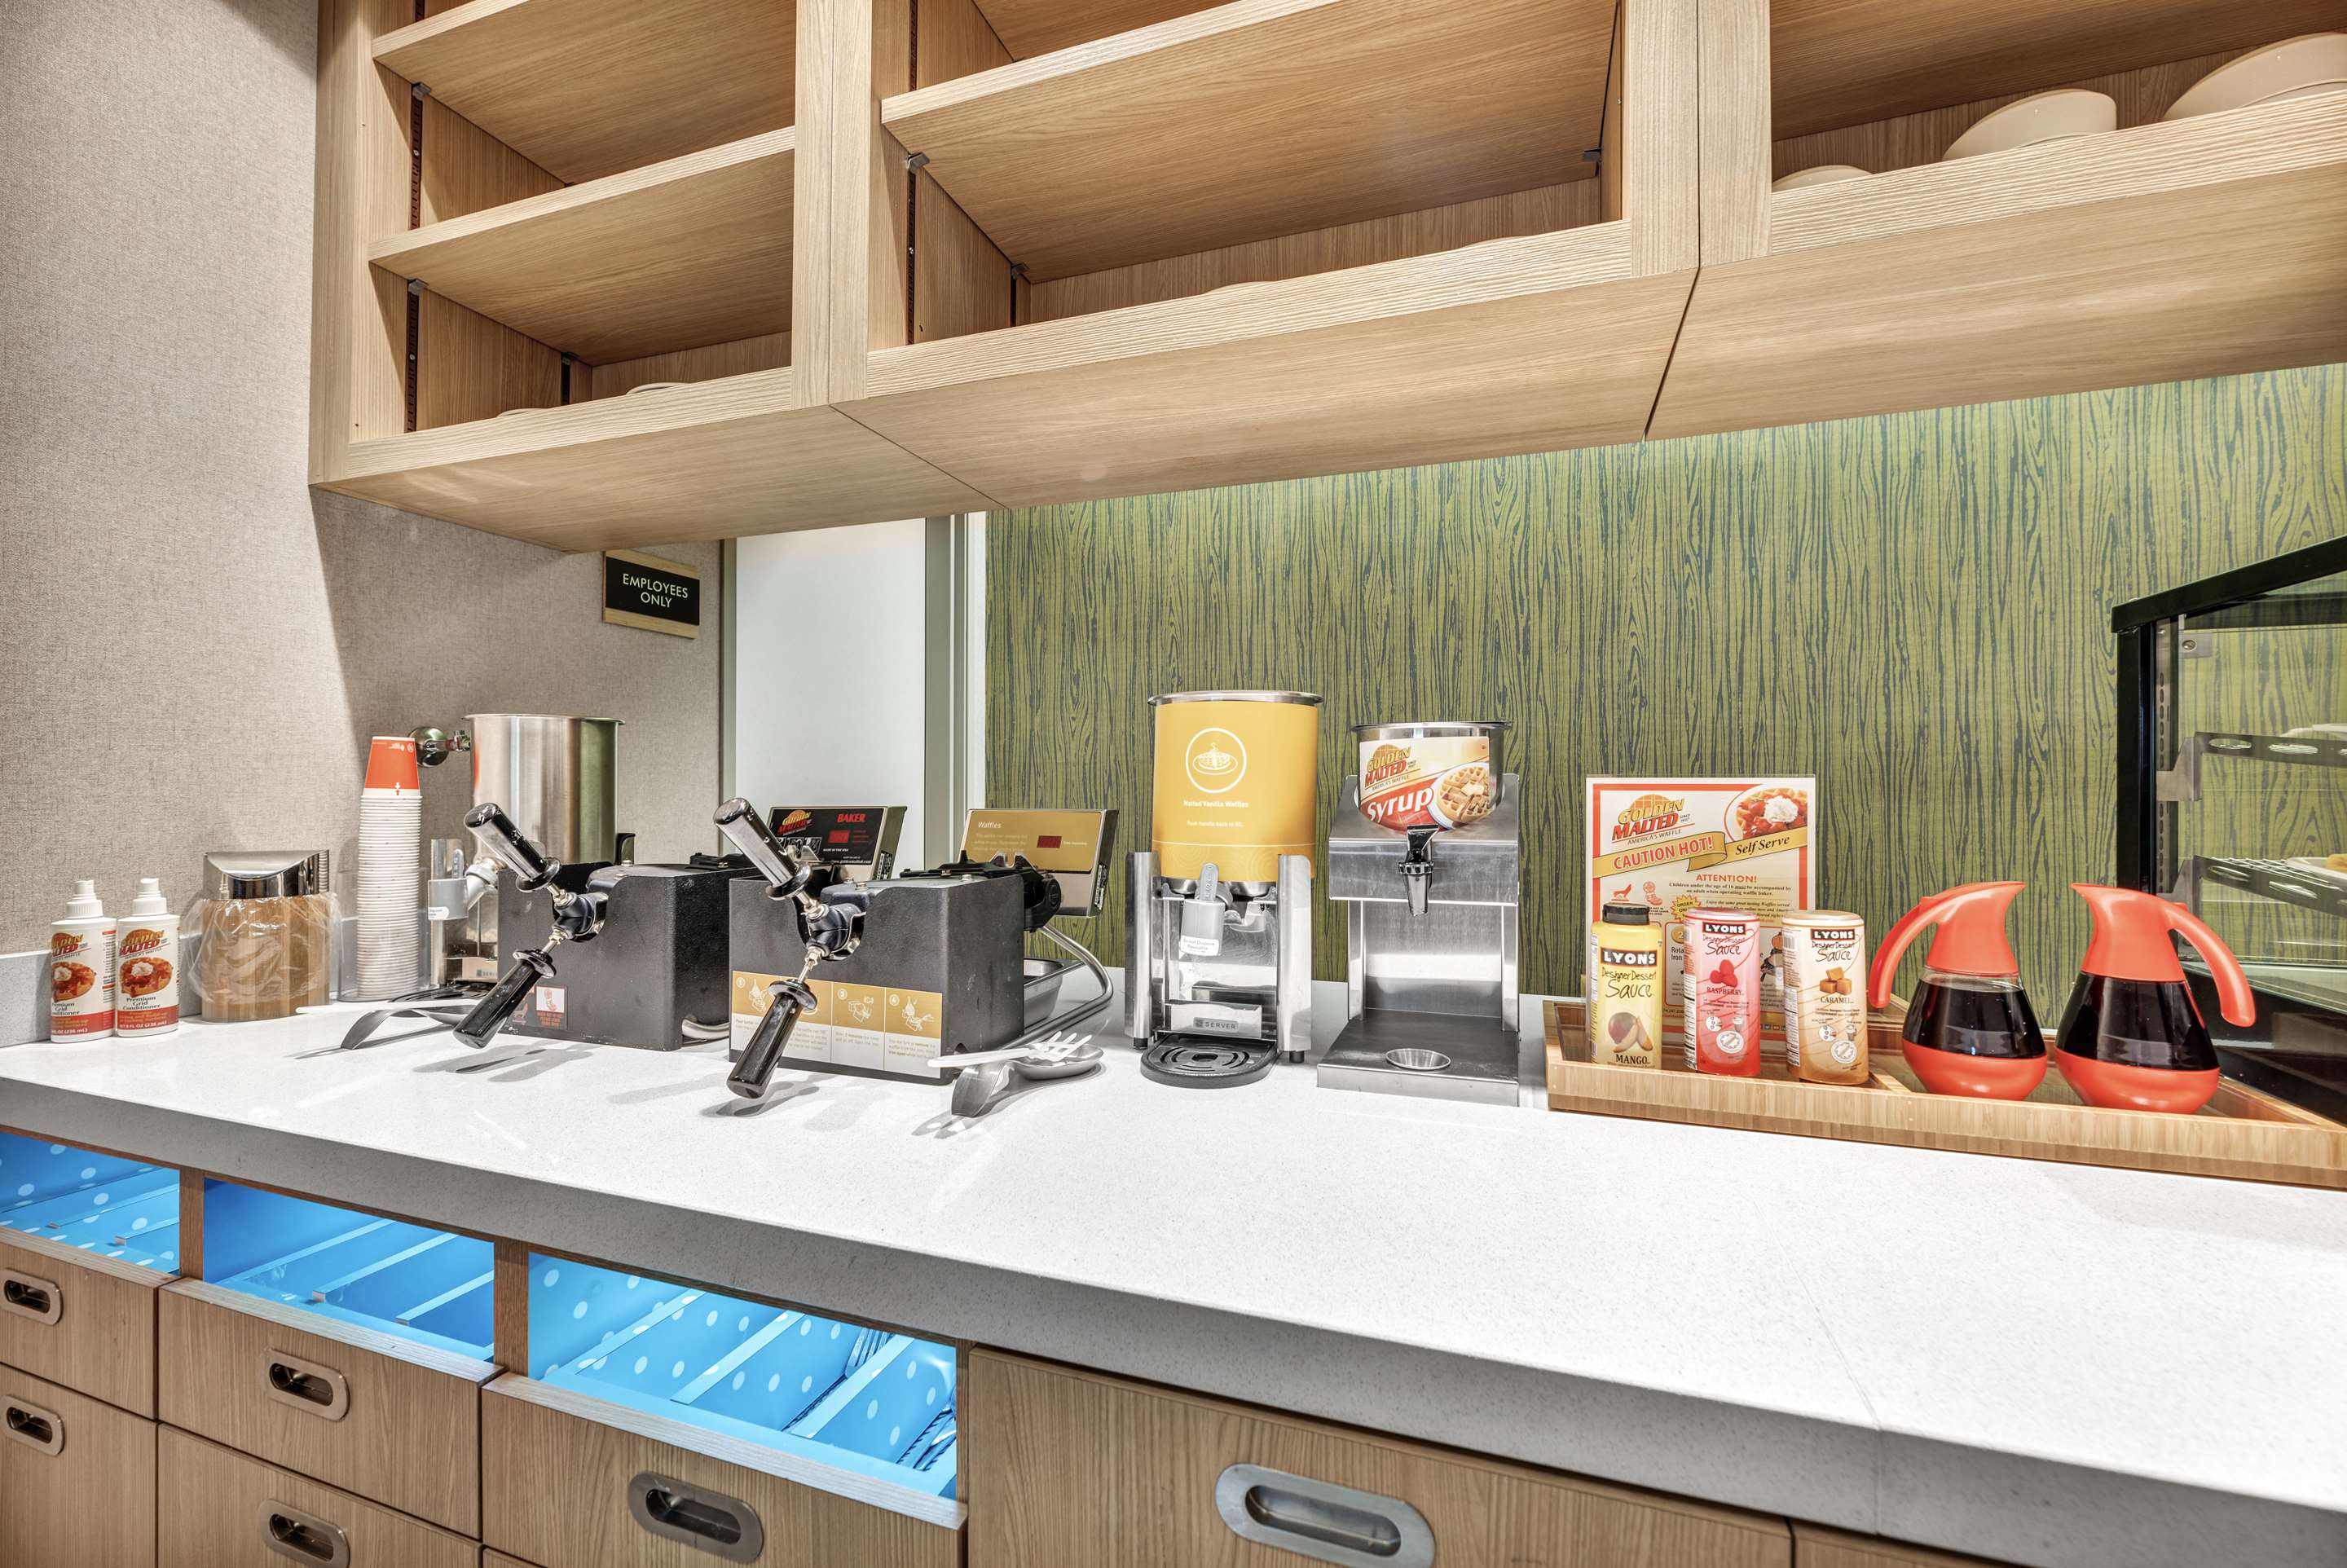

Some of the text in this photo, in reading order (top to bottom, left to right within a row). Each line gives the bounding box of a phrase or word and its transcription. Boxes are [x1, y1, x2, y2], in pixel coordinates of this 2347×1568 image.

[623, 573, 689, 599] EMPLOYEES
[641, 592, 672, 608] ONLY
[1367, 747, 1411, 773] GOLDEN
[1365, 759, 1407, 788] MALTED
[1392, 775, 1409, 784] WAFFLE
[1367, 786, 1434, 823] Syrup
[1618, 798, 1684, 825] GOLDEN
[837, 813, 866, 823] BAKER
[1612, 813, 1679, 841] MALTED
[1627, 830, 1681, 845] AMERICA'S WAFFLE
[1736, 836, 1790, 855] Self Serve
[1614, 836, 1713, 870] CAUTION HOT!
[1696, 874, 1757, 883] ATTENTION!
[1705, 924, 1744, 933] LYONS
[1814, 931, 1853, 939] LYONS
[1705, 941, 1742, 955] Sauce
[1603, 951, 1656, 965] LYONS
[1815, 949, 1852, 962] Sauce
[1601, 967, 1657, 982] Designer Dessert
[1605, 978, 1653, 998] Sauce
[1706, 987, 1742, 995] RASPBERRY
[1821, 996, 1851, 1004] CARAMEL
[1205, 1021, 1236, 1030] SERVER
[1615, 1054, 1648, 1064] MANGO
